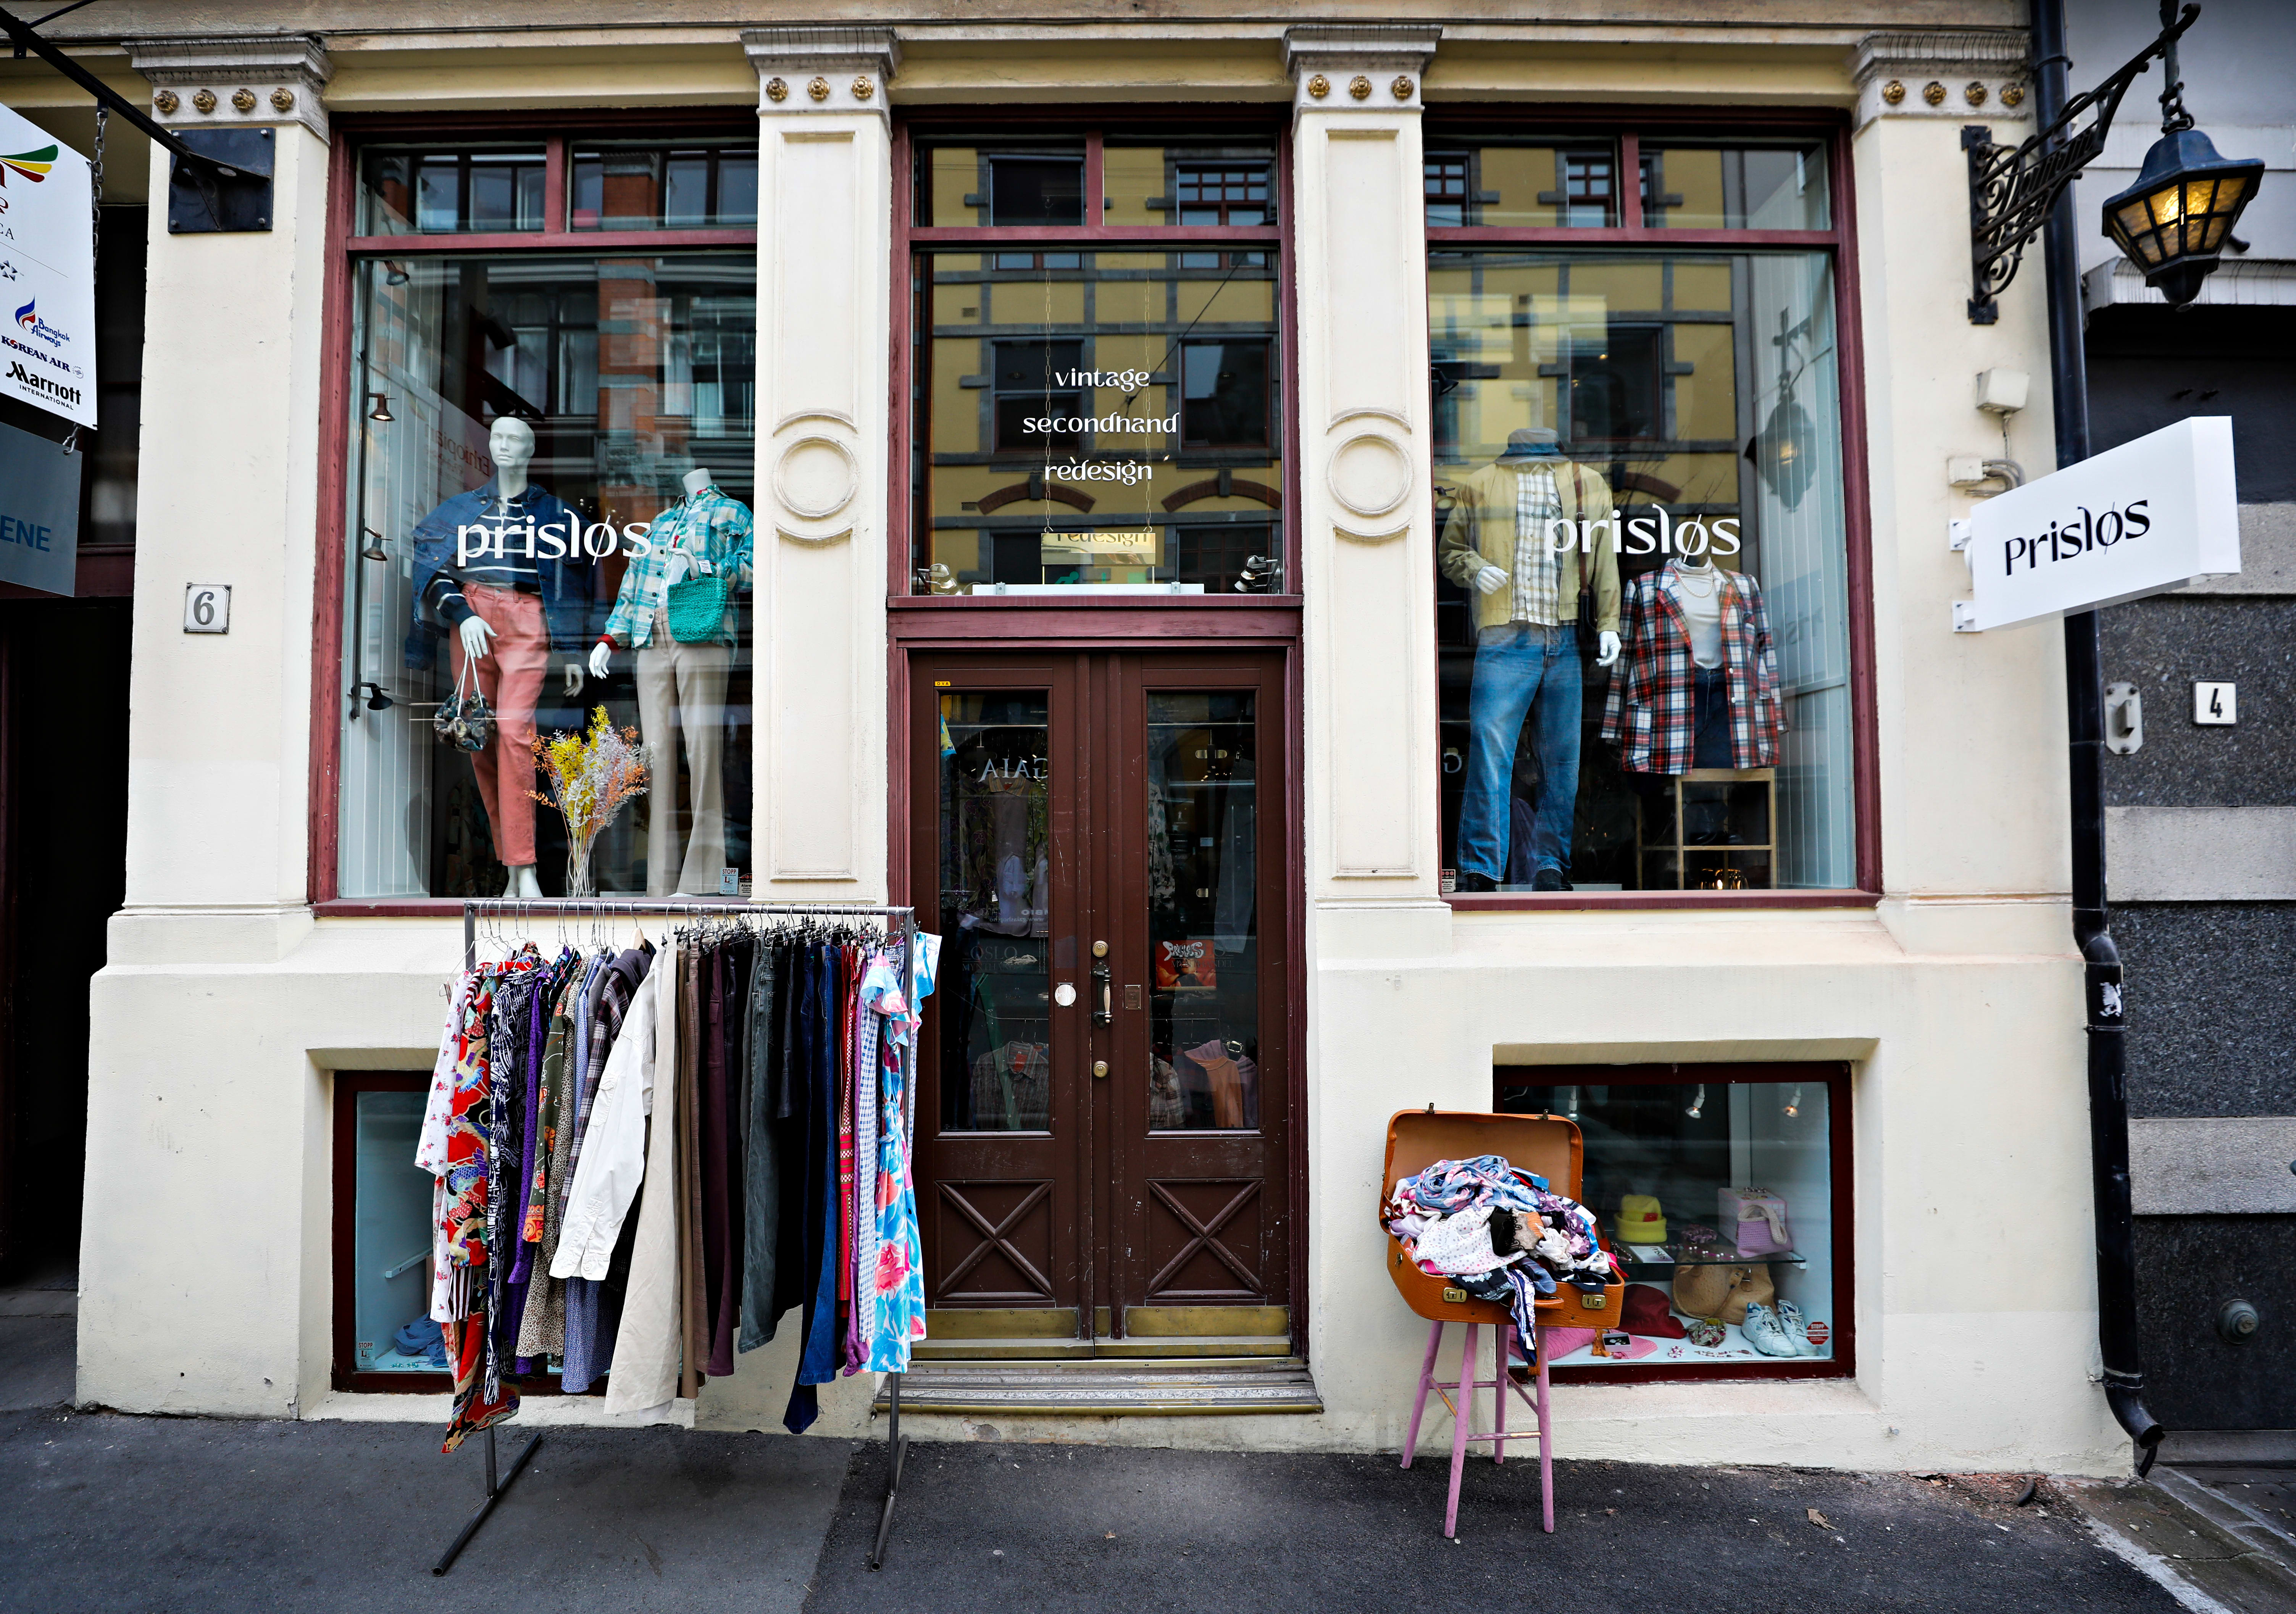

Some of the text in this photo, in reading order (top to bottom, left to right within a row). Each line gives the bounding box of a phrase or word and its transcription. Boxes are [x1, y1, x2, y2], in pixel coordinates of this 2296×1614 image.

[30, 325, 61, 348] Airways
[38, 316, 70, 342] Bangkok
[1, 335, 71, 372] KOREAN AIR
[5, 361, 81, 405] Marriott
[1055, 368, 1150, 392] vintage
[19, 384, 74, 411] INTERNATIONAL
[1023, 411, 1180, 434] secondhand
[457, 508, 653, 568] prisløs
[1544, 503, 1741, 564] prisløs
[2004, 498, 2151, 577] Prisløs
[194, 592, 214, 625] 6
[2210, 688, 2223, 718] 4
[970, 946, 1018, 960] OSLO
